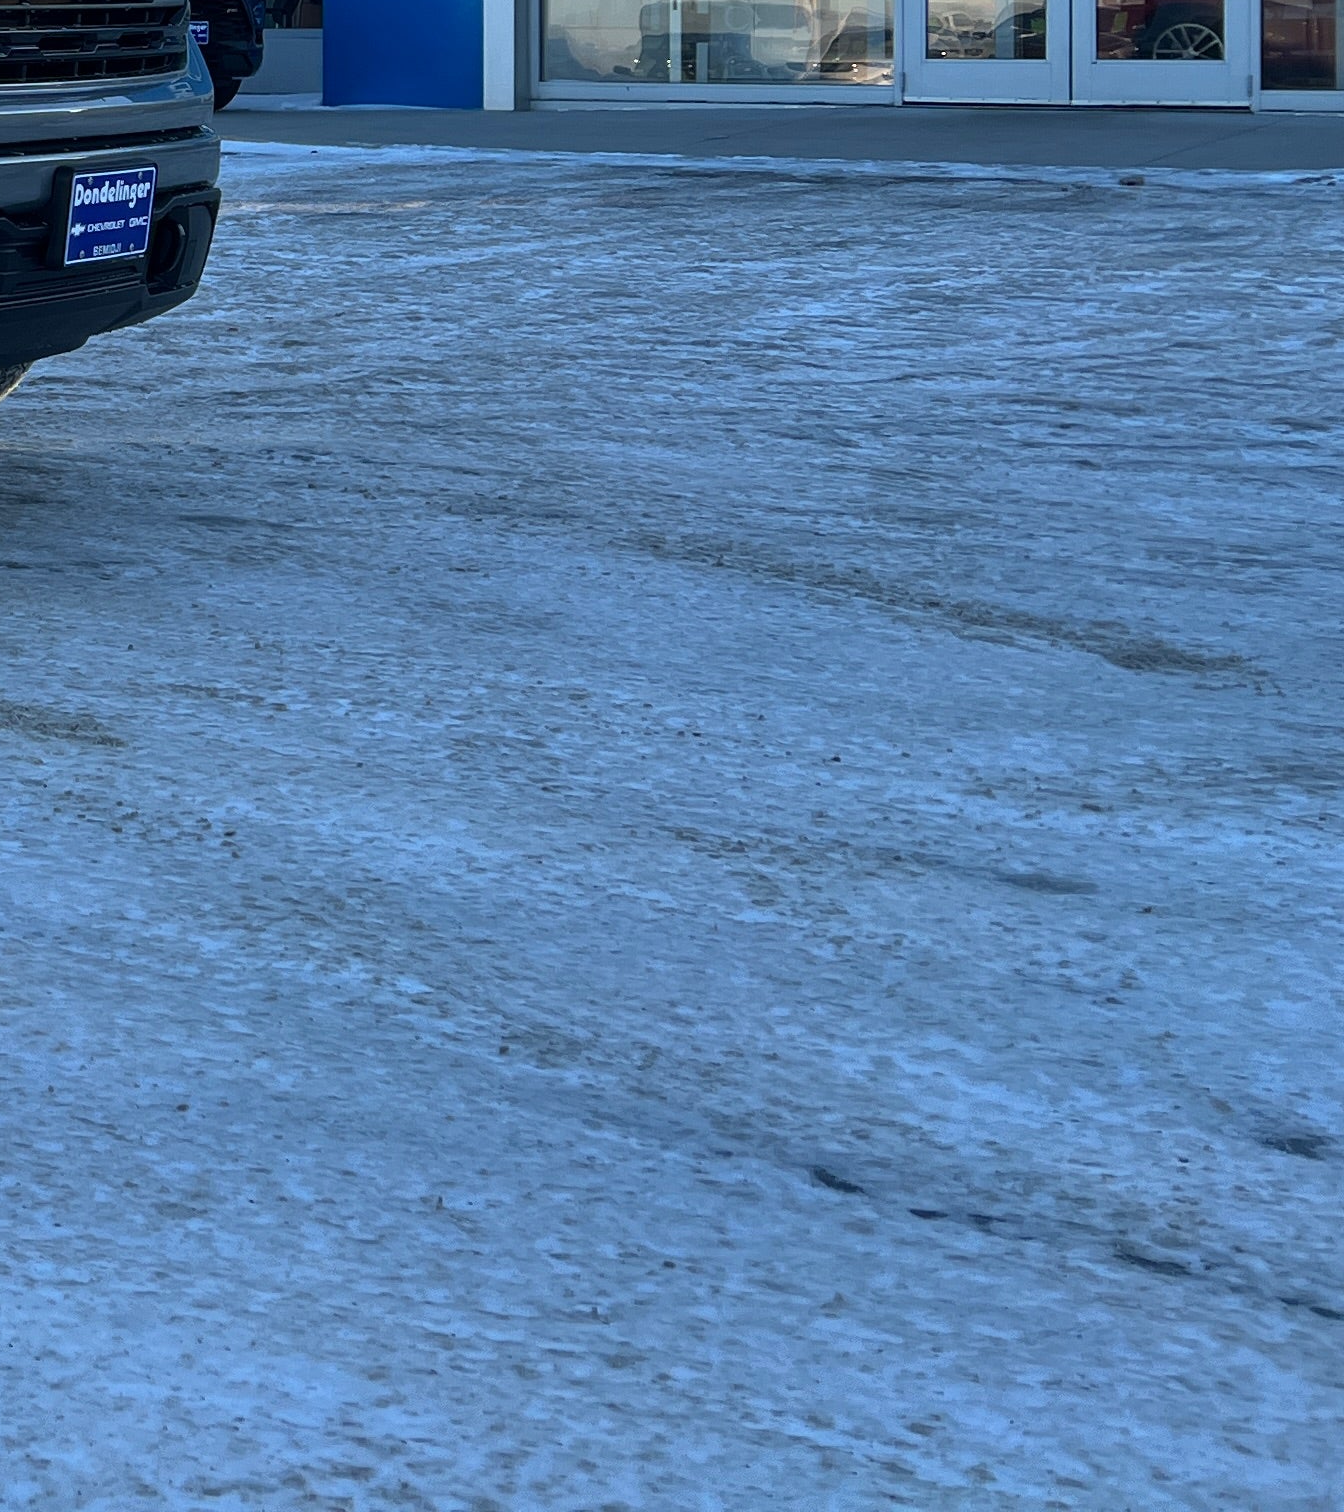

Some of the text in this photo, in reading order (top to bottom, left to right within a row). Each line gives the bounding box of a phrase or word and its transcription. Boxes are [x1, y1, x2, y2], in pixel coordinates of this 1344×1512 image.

[74, 179, 151, 209] Dondelinger
[87, 215, 149, 233] CHEVROLET GMC
